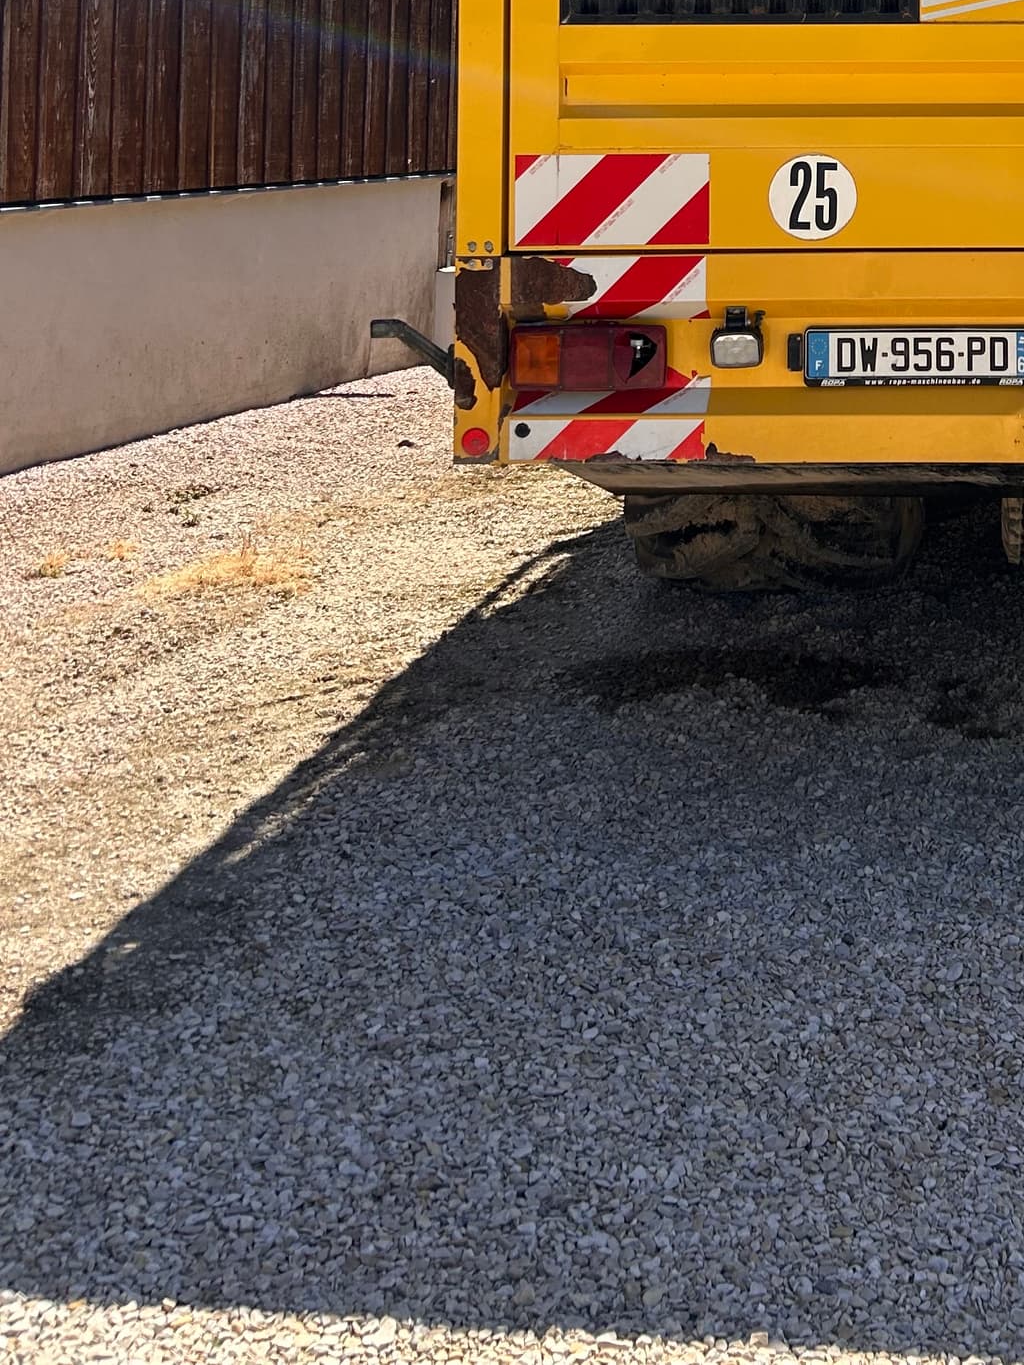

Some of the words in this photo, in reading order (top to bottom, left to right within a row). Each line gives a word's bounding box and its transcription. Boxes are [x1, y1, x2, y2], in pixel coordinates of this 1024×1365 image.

[789, 161, 838, 231] 25
[815, 360, 823, 371] F
[837, 337, 1008, 372] DW-956-PD
